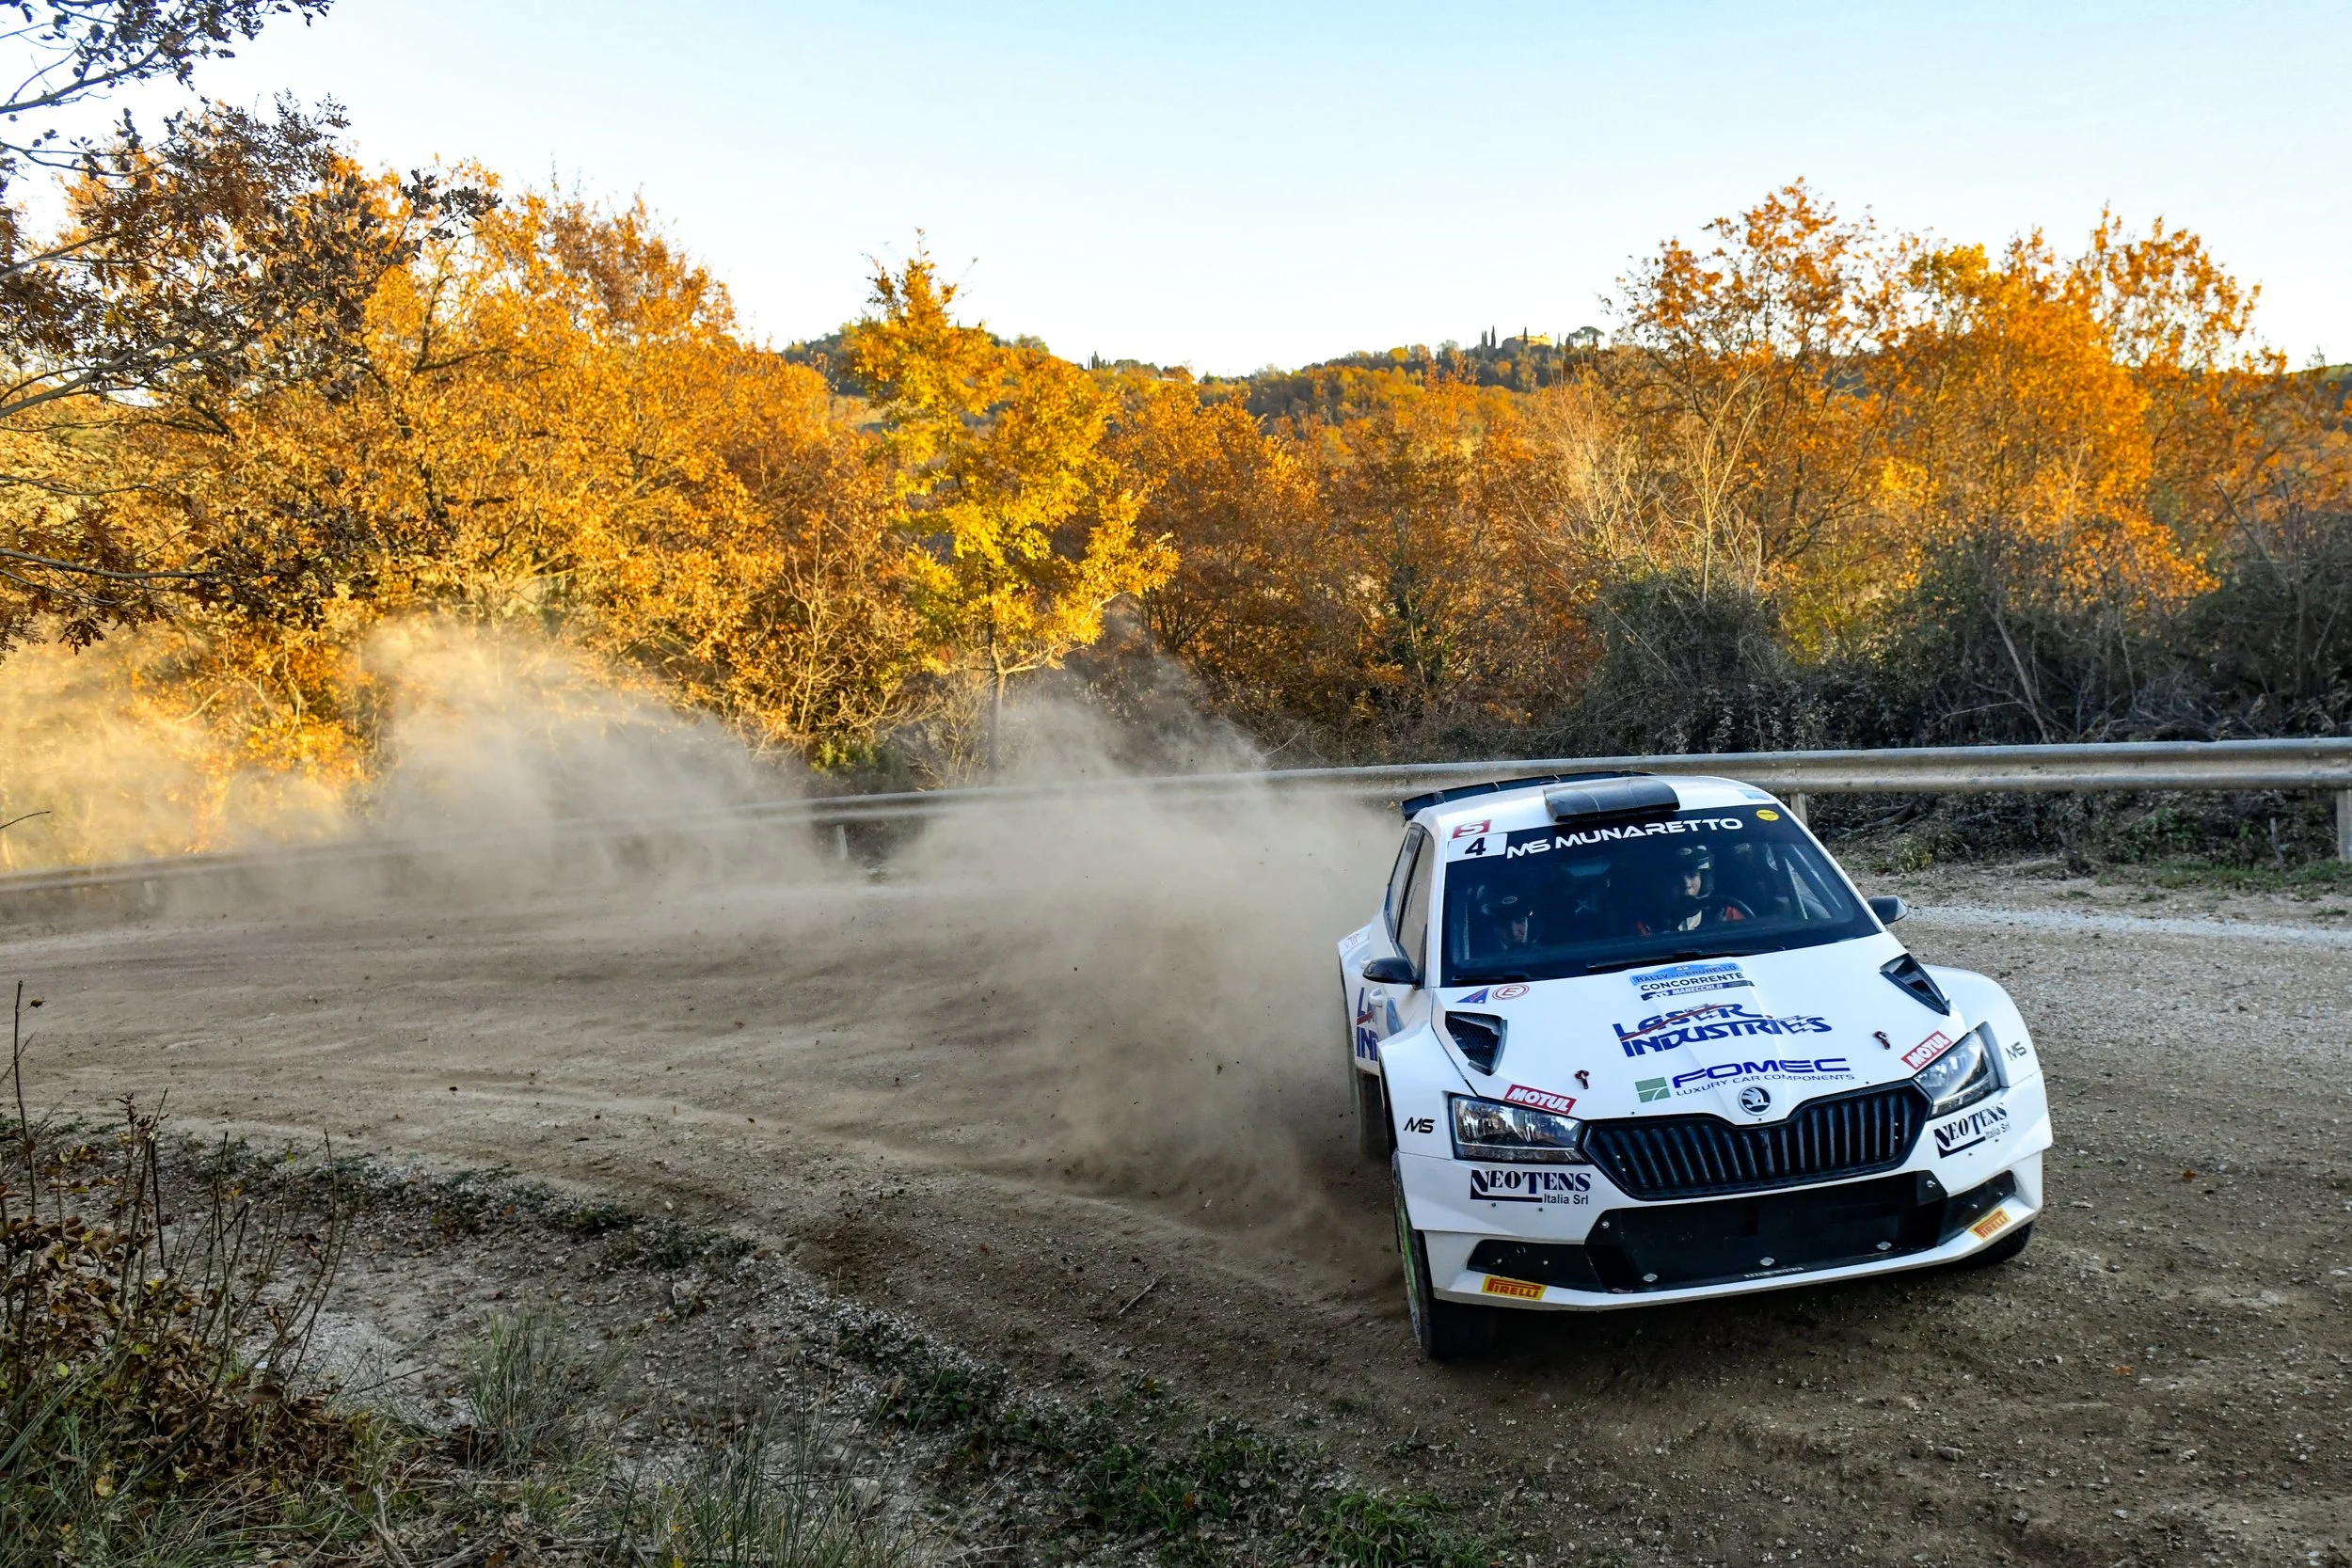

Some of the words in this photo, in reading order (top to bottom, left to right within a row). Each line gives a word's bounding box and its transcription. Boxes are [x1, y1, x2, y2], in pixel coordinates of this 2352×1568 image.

[1465, 837, 1486, 856] 4
[1506, 838, 1551, 859] MS
[1555, 817, 1742, 849] MUNARETTO
[1641, 973, 1745, 991] CONCORRENTE
[1621, 1015, 1833, 1057] INDUSTRIES
[1906, 1034, 1949, 1068] MOTUL
[2005, 1041, 2027, 1061] MS
[1672, 1058, 1851, 1089] FOMEC
[1676, 1079, 1728, 1096] LUXURY
[1732, 1074, 1761, 1084] CAR
[1764, 1073, 1855, 1082] COMPONENTS
[1507, 1086, 1571, 1112] MOTUL
[1404, 1117, 1436, 1134] MS
[1934, 1102, 2008, 1148] NEOTENS
[1470, 1169, 1592, 1197] NEOTENS
[1544, 1194, 1569, 1205] Italia
[1573, 1195, 1589, 1205] Srl
[1486, 1277, 1542, 1298] PIRELLI
